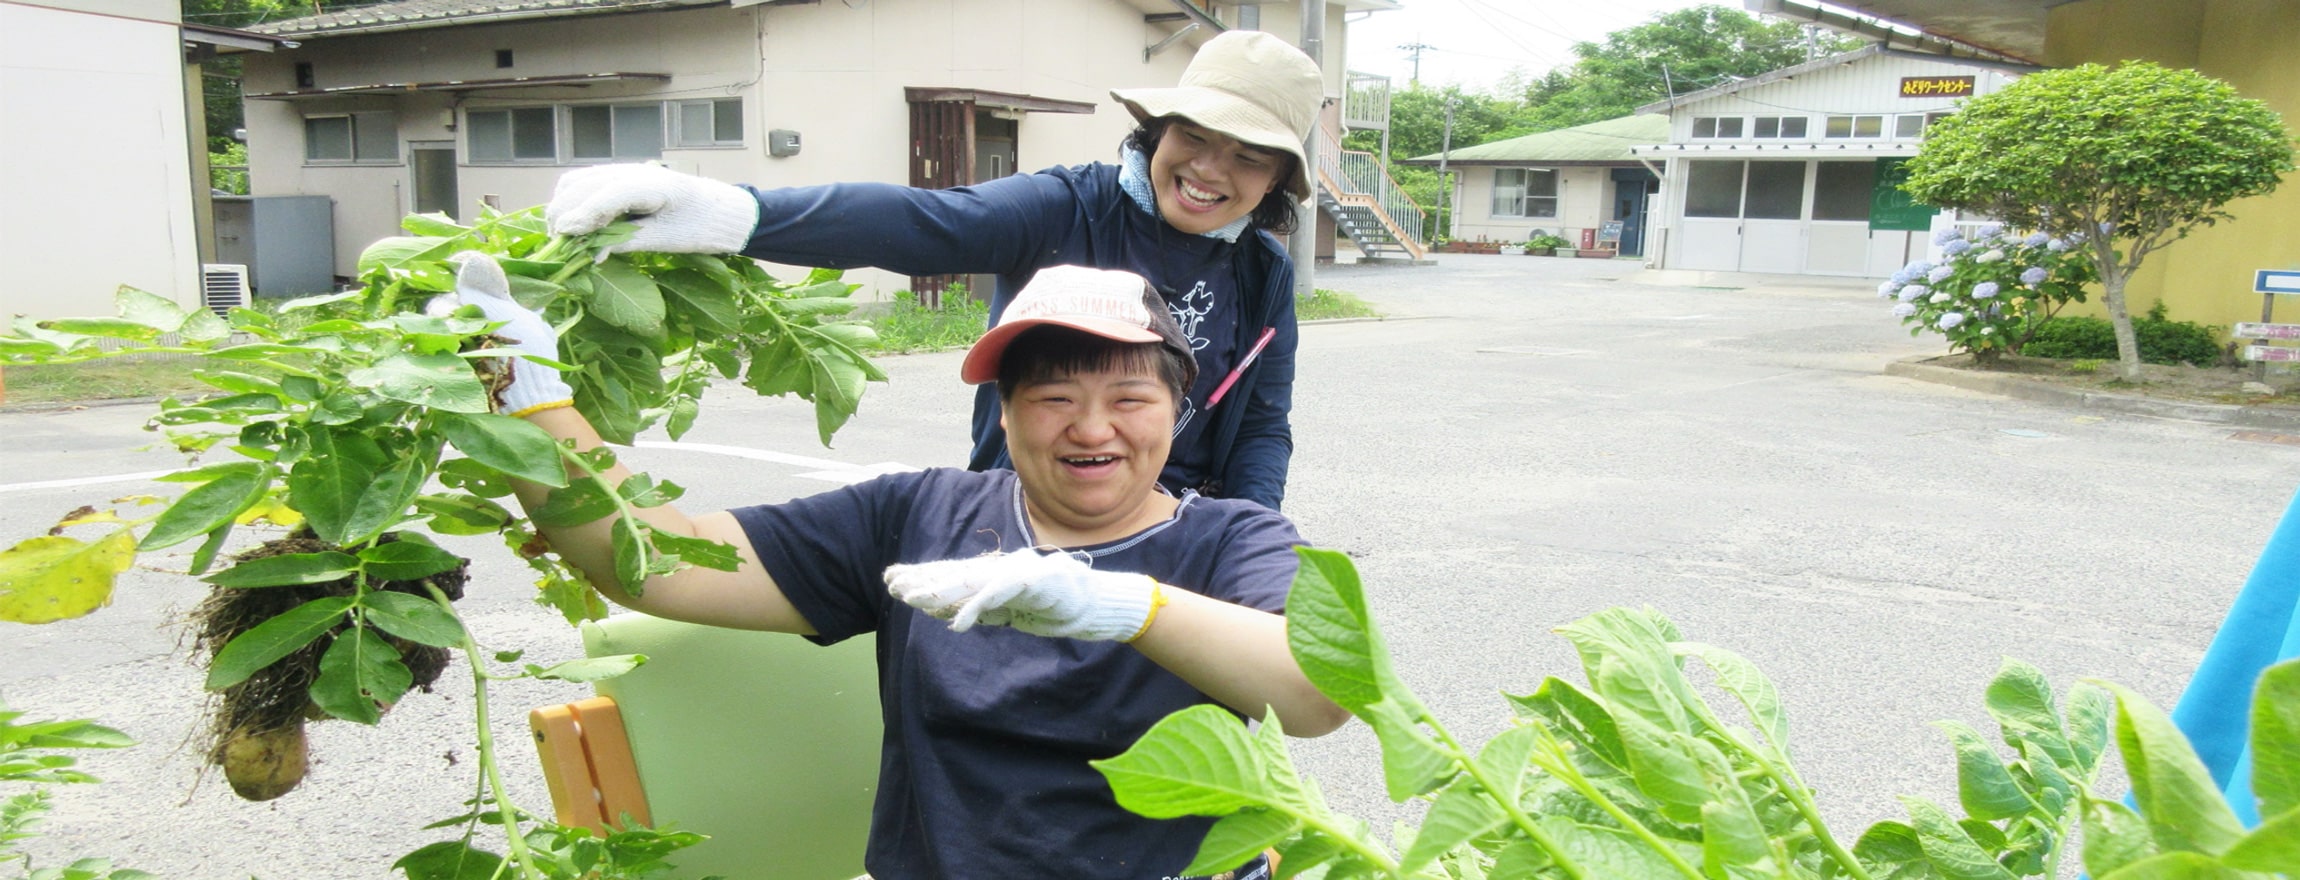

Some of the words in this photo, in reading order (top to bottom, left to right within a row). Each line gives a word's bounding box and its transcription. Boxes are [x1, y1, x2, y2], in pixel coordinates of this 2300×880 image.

[1903, 79, 1972, 95] みどりワークセンター
[1071, 296, 1136, 321] SUMMER
